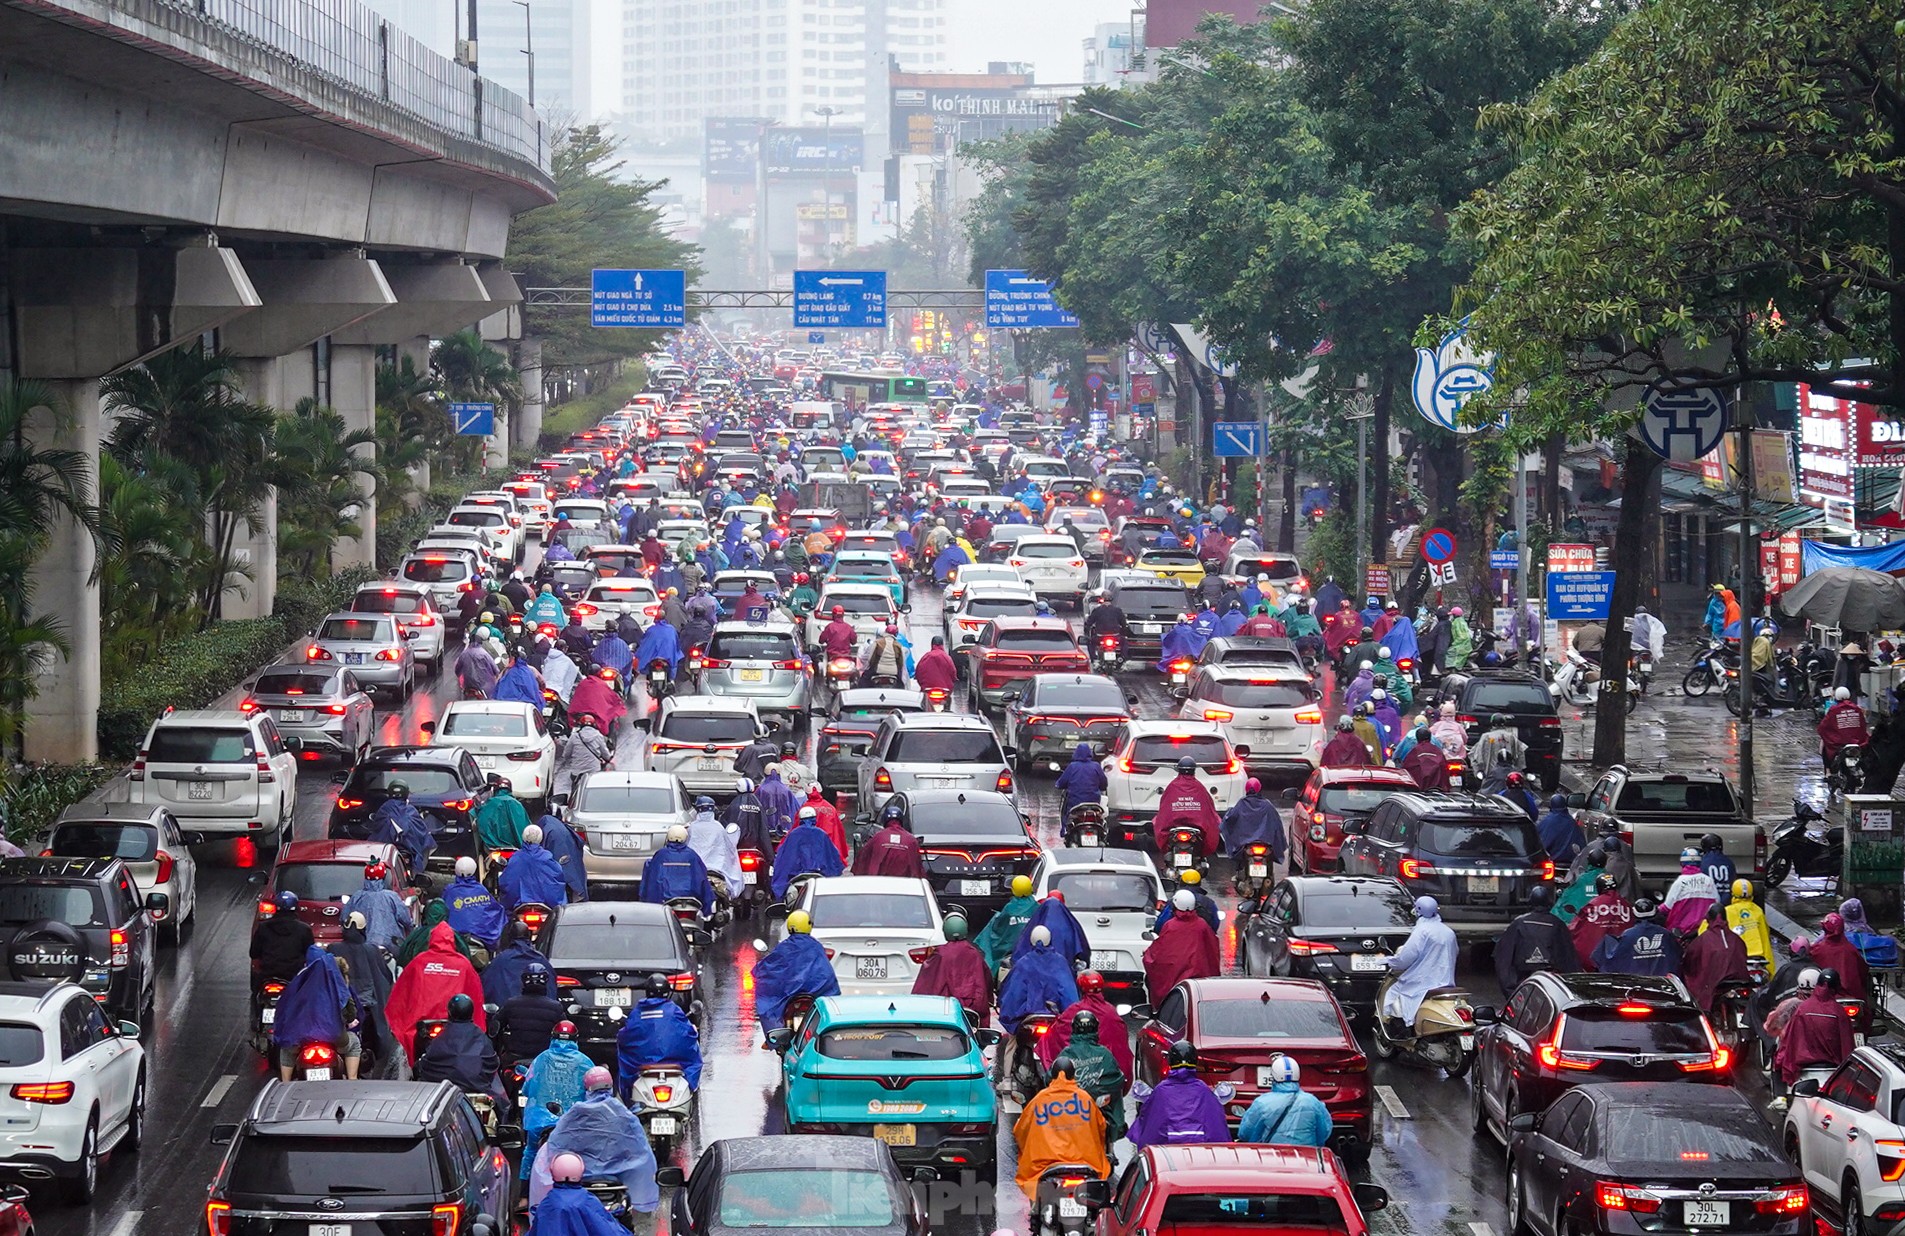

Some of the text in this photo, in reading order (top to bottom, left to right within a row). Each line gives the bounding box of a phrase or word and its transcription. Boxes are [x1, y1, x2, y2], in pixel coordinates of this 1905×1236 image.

[606, 291, 619, 299] GIAO
[606, 303, 619, 311] GIAO
[811, 304, 824, 312] GIAO
[1001, 303, 1014, 311] GIAO
[1549, 546, 1593, 559] SỬA CHỮA
[1784, 558, 1795, 569] XE
[1781, 572, 1798, 584] MÁY
[1555, 584, 1566, 593] BAN
[1587, 899, 1630, 923] yody
[14, 954, 79, 965] SUZUKI
[864, 957, 880, 968] 30A
[857, 967, 886, 978] 060.76
[599, 997, 628, 1005] 188.13
[1034, 1092, 1091, 1125] yody
[886, 1126, 904, 1135] 29H
[1698, 1203, 1717, 1213] 30L
[1689, 1213, 1724, 1223] 272.71
